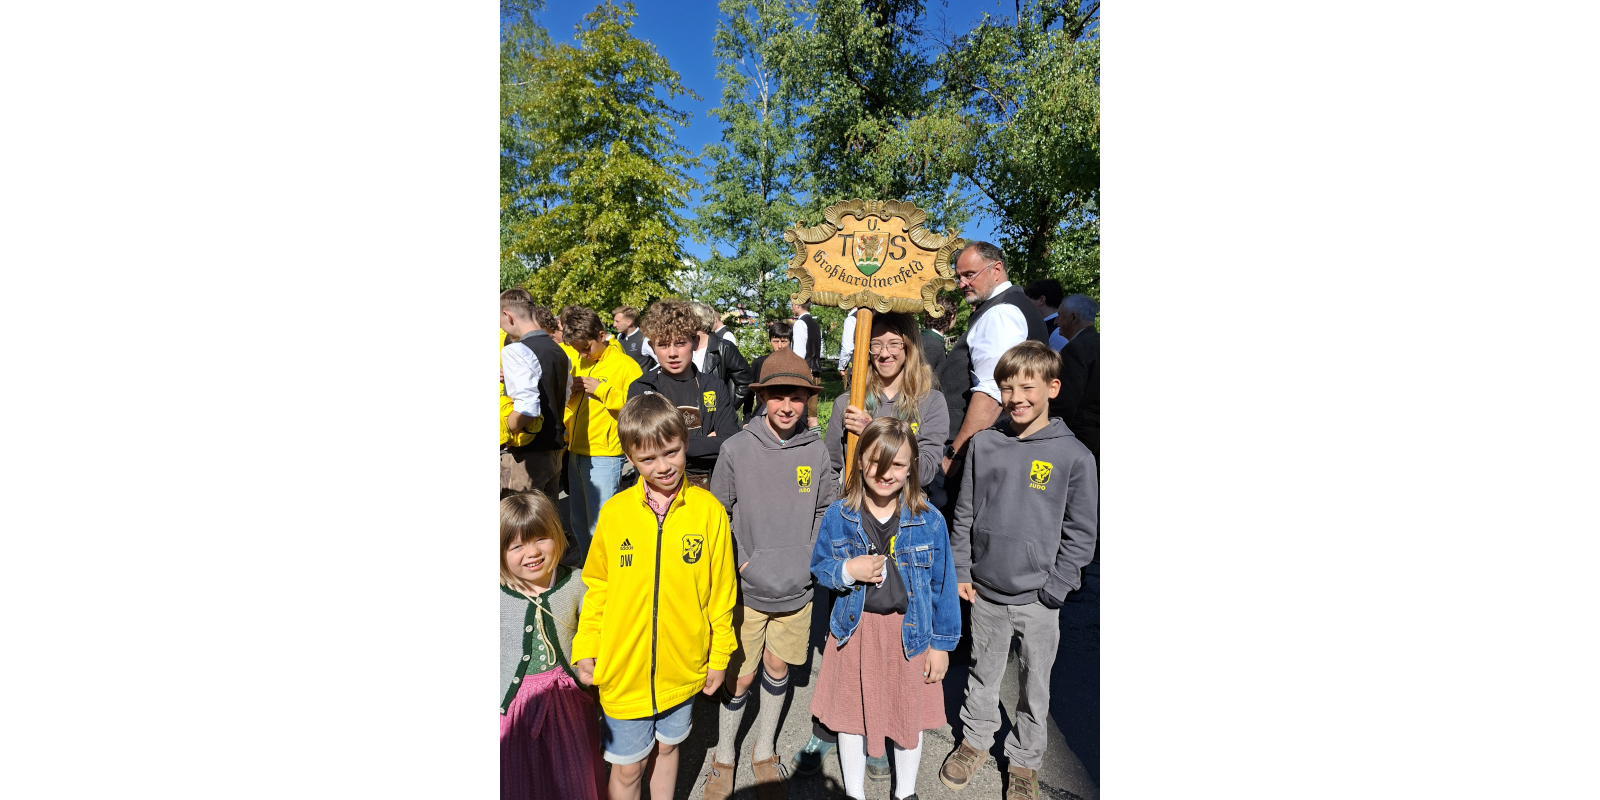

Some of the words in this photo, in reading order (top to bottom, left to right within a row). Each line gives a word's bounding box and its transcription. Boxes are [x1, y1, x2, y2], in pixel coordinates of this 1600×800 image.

[838, 233, 854, 257] T
[889, 235, 907, 260] S
[813, 249, 924, 288] Großkarolinenfeld
[1029, 482, 1046, 491] JUDO
[620, 554, 633, 568] DW
